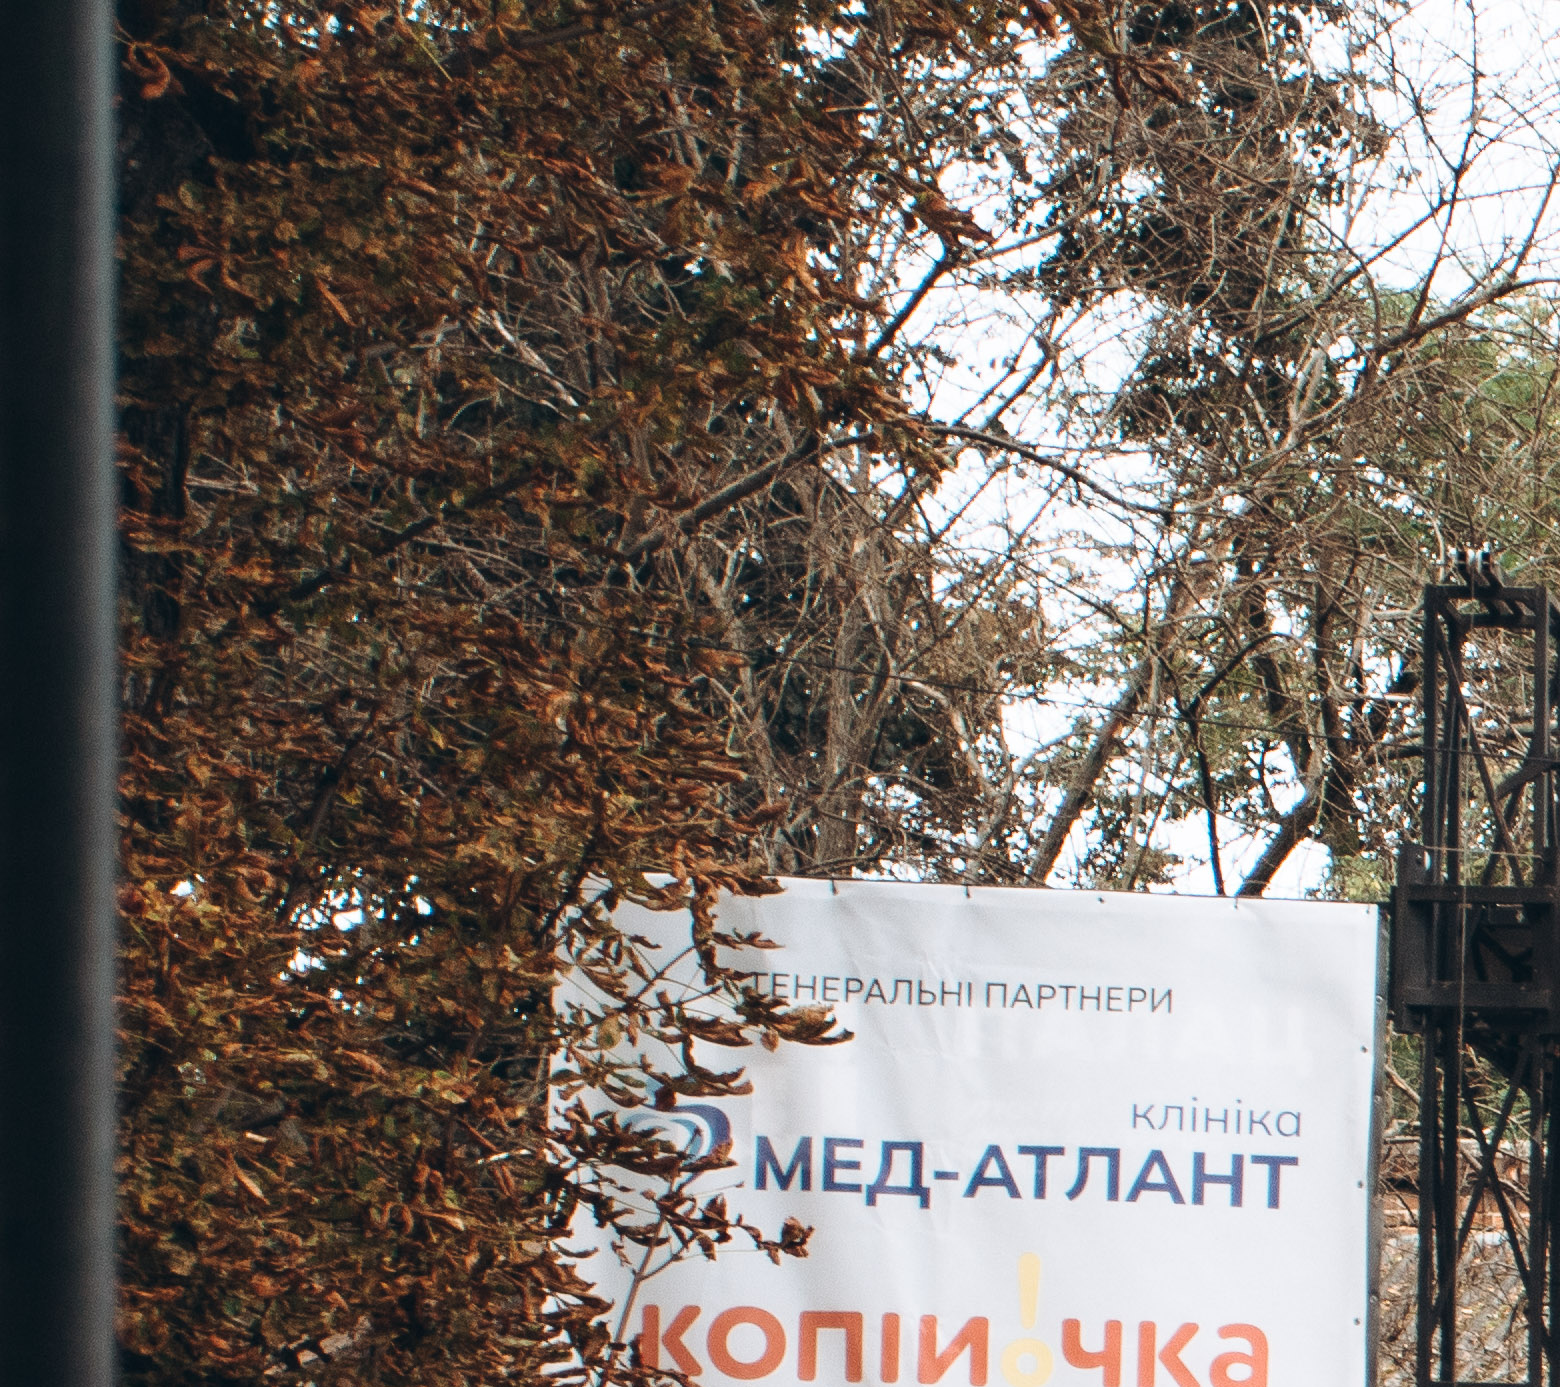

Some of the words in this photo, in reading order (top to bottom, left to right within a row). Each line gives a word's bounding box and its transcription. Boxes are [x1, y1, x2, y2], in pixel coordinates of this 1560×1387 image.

[985, 981, 1174, 1015] ПАРТНЕРИ
[1131, 1097, 1303, 1138] клініка
[754, 1134, 1299, 1210] МЕД-АТЛАНТ
